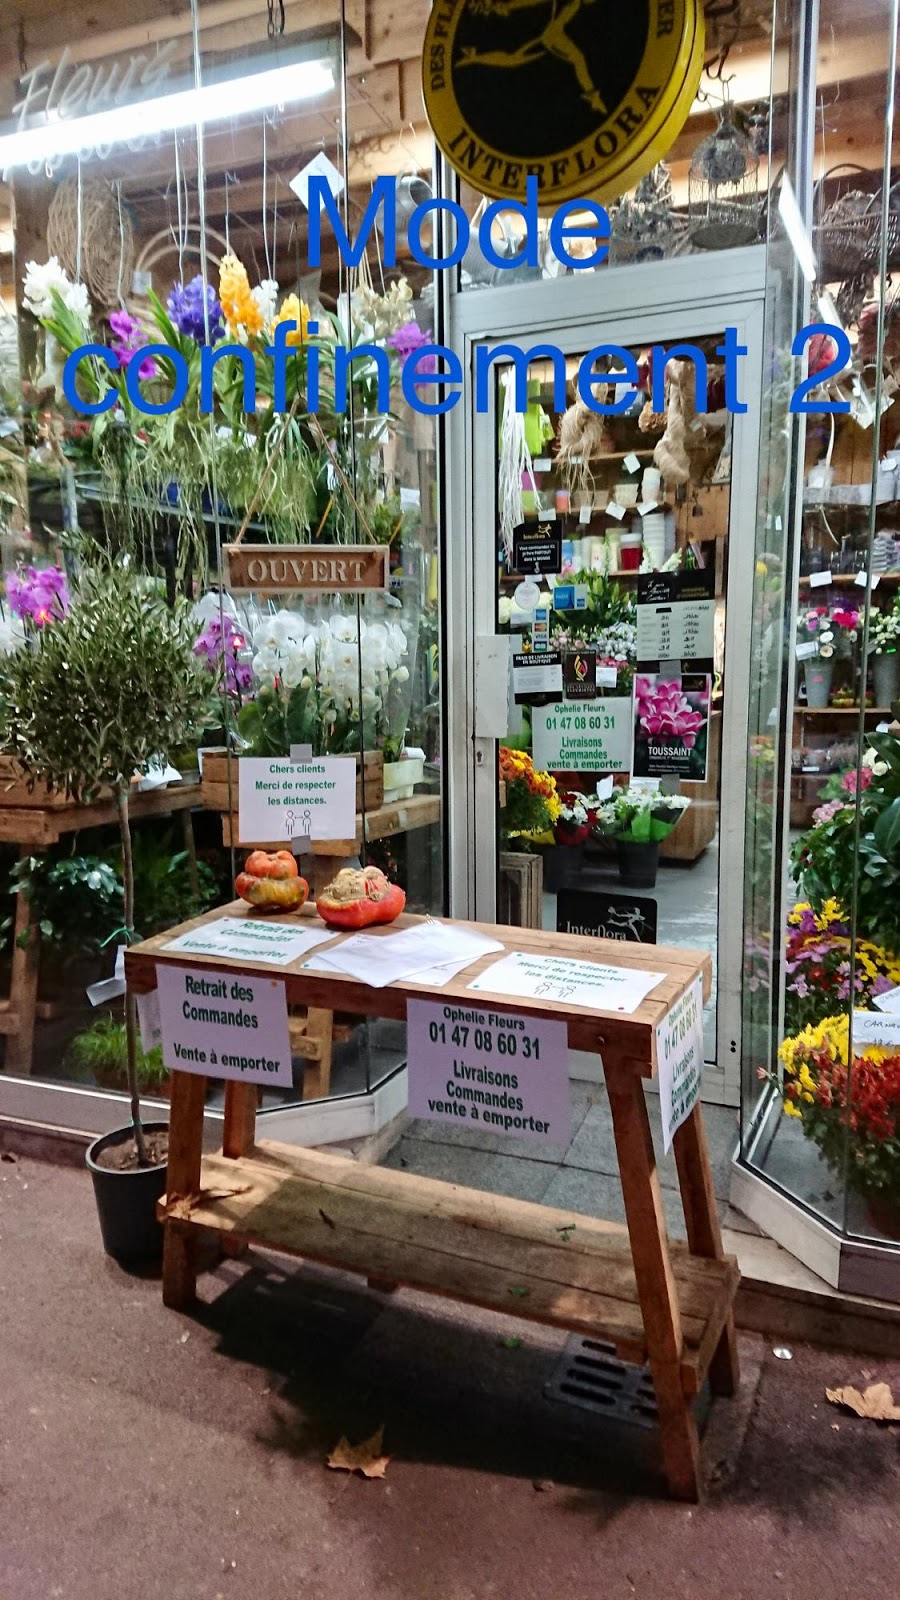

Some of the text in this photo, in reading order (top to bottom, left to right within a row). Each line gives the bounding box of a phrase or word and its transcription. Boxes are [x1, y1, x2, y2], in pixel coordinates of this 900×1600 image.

[430, 43, 446, 92] DES
[448, 86, 661, 190] INTERFLORA
[248, 558, 366, 583] OUVERT
[555, 704, 605, 714] Ophelie Fleurs
[546, 716, 615, 730] 01 47 08 60 31
[562, 736, 602, 748] Livraisons
[648, 746, 691, 756] TOUSSAINT
[560, 749, 608, 759] Commandes
[270, 764, 326, 774] Chers clients
[547, 760, 622, 770] vente à emporter
[256, 781, 336, 790] Merci de respecter
[268, 796, 326, 805] les distances.
[220, 929, 294, 942] Commandes
[240, 922, 306, 934] Retrait des
[567, 921, 627, 941] Interflora
[183, 940, 217, 949] Vente
[229, 946, 288, 958] emporter
[518, 961, 628, 982] Merci de respecter
[544, 958, 618, 974] Chers clients
[525, 970, 606, 987] les distances.
[186, 976, 254, 1002] Retrait des
[182, 1001, 258, 1028] Commandes
[444, 1006, 525, 1030] Ophelie Fleurs
[429, 1022, 540, 1060] 01 47 08 60 31
[174, 1043, 280, 1073] Vente à emporter
[454, 1060, 518, 1089] Livraisons
[446, 1080, 524, 1112] Commandes
[428, 1100, 550, 1134] vente à emporter
